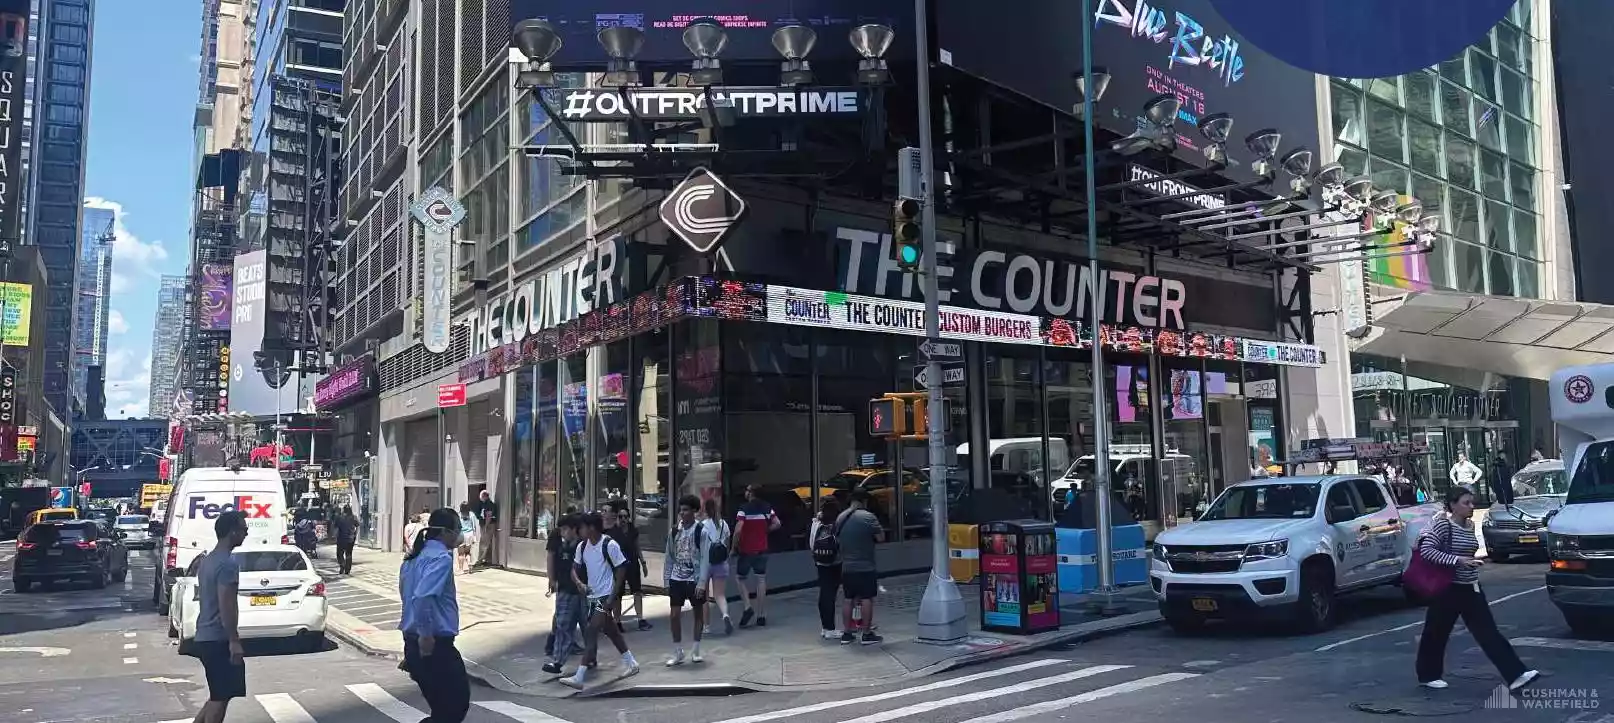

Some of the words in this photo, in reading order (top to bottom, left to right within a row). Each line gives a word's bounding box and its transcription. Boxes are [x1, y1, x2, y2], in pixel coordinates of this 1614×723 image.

[1168, 11, 1245, 87] Beetle
[1146, 65, 1163, 79] ONLY
[1172, 78, 1204, 101] THEATERS
[237, 262, 264, 285] BEATS
[836, 227, 957, 301] THE
[971, 250, 1186, 330] COUNTER
[236, 282, 266, 304] STUDIO
[468, 298, 501, 358] THE
[501, 236, 620, 346] COUNTER
[785, 299, 831, 320] COUNTER
[845, 301, 871, 324] THE
[938, 311, 981, 334] CUSTOM
[984, 316, 1032, 339] BURGERS
[944, 344, 959, 356] WAY
[1276, 346, 1289, 361] THE
[1289, 347, 1317, 363] COUNTER
[944, 369, 961, 382] WAY
